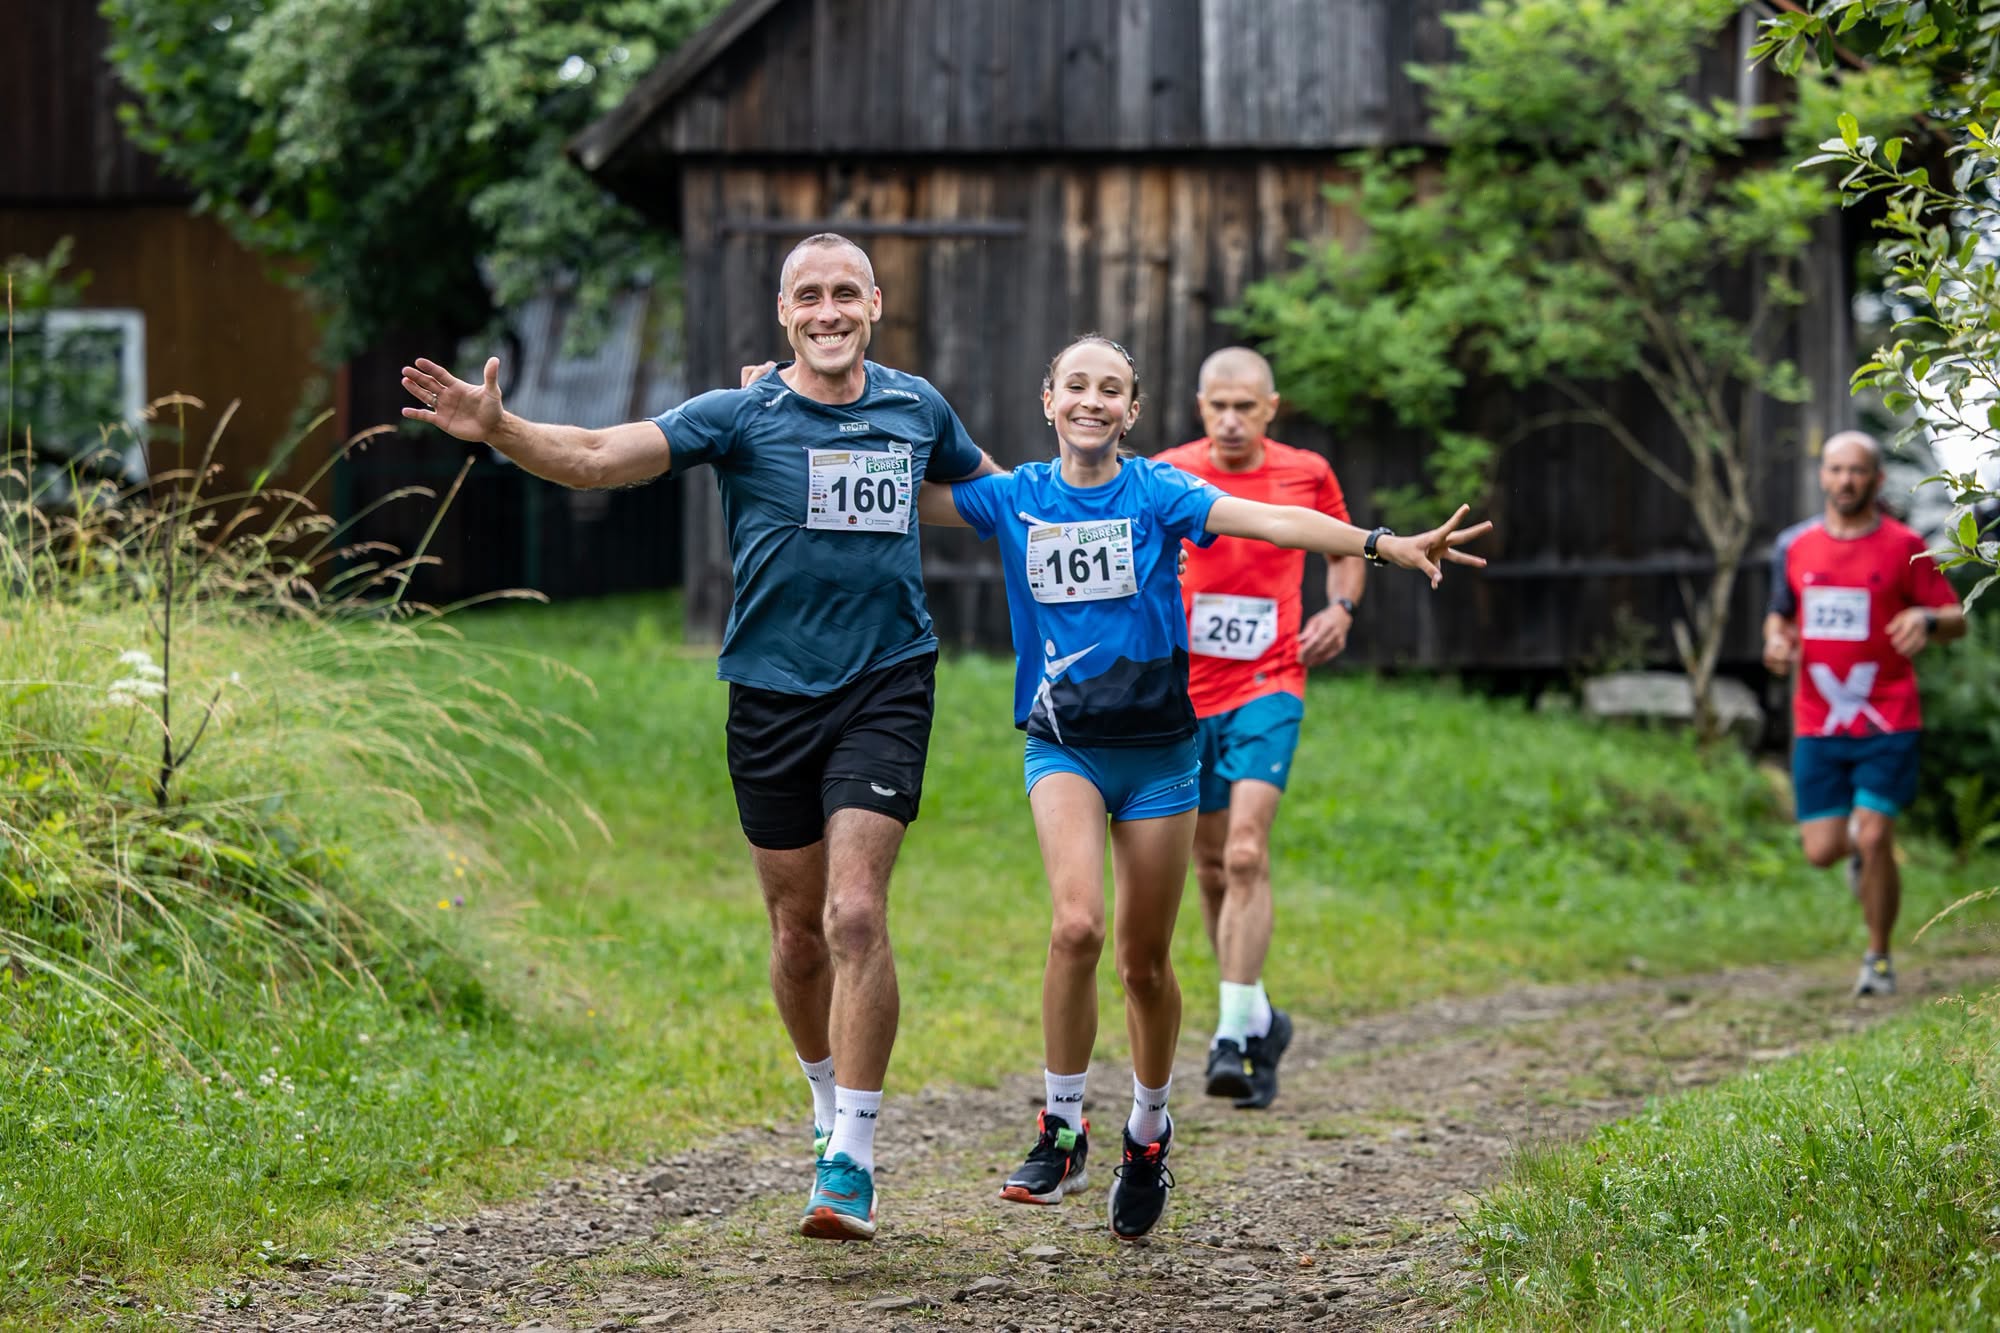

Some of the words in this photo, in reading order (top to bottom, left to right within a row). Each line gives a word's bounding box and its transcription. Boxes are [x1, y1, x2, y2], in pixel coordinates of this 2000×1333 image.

[867, 460, 905, 473] FORREST
[831, 476, 896, 514] 160
[1079, 525, 1122, 543] FORREST
[1046, 546, 1110, 585] 161
[1208, 616, 1259, 645] 267
